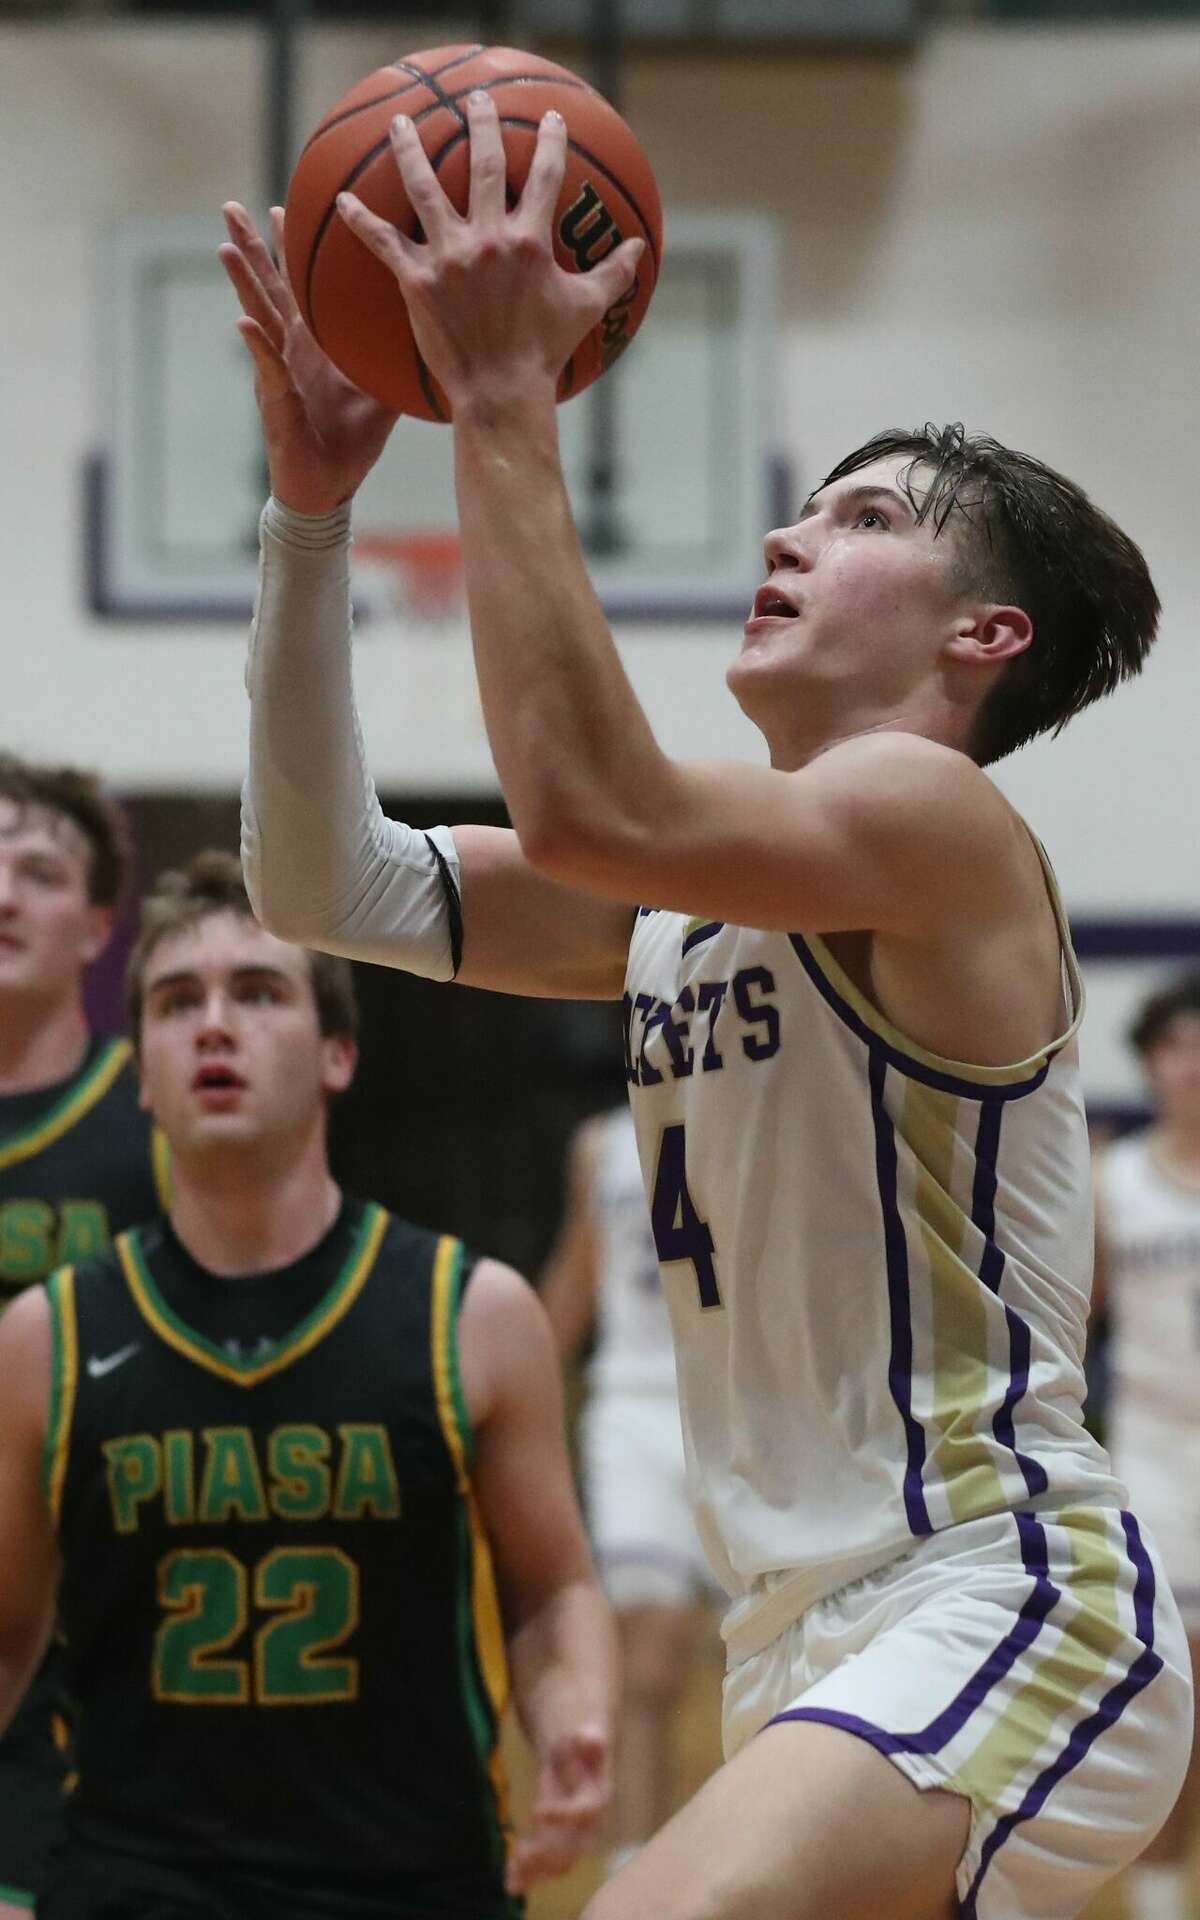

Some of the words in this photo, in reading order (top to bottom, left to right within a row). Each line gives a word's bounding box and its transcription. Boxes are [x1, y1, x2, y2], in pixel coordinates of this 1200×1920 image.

[651, 1123, 721, 1309] 4
[101, 1423, 401, 1535] PIASA
[153, 1546, 360, 1705] 22
